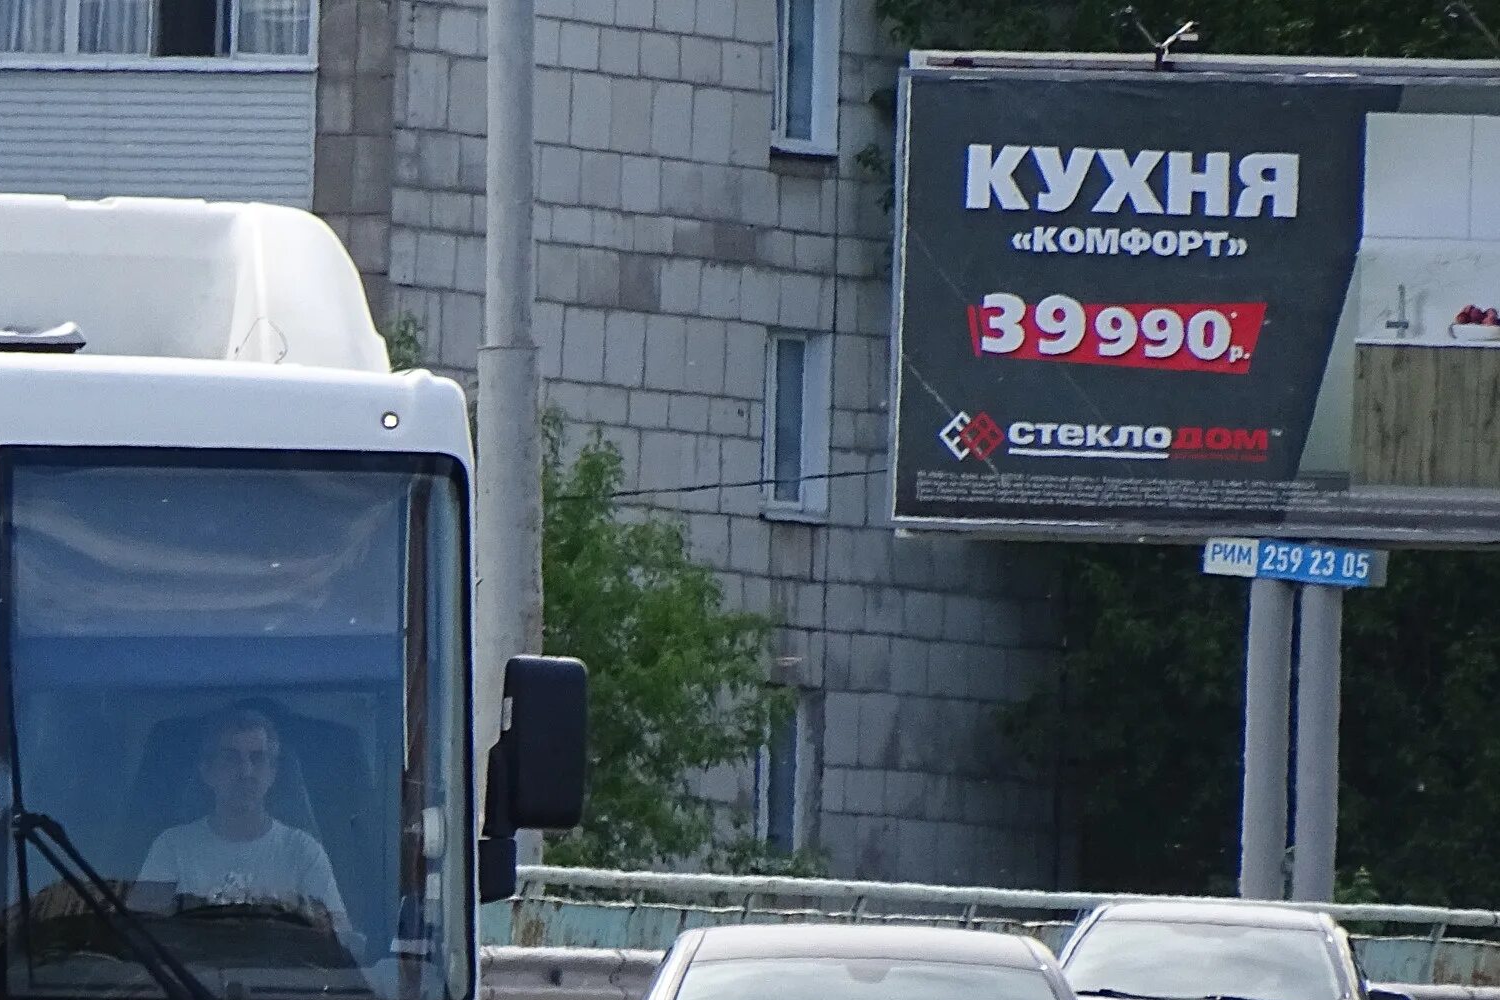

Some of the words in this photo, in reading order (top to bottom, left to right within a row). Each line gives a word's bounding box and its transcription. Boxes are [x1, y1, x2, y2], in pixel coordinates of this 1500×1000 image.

[965, 143, 1300, 218] КУХНЯ
[1012, 226, 1248, 257] «КОМФОРТ»
[1211, 543, 1252, 565] РИМ
[1262, 545, 1303, 573] 259
[1309, 550, 1336, 576] 23
[1342, 552, 1370, 579] 05
